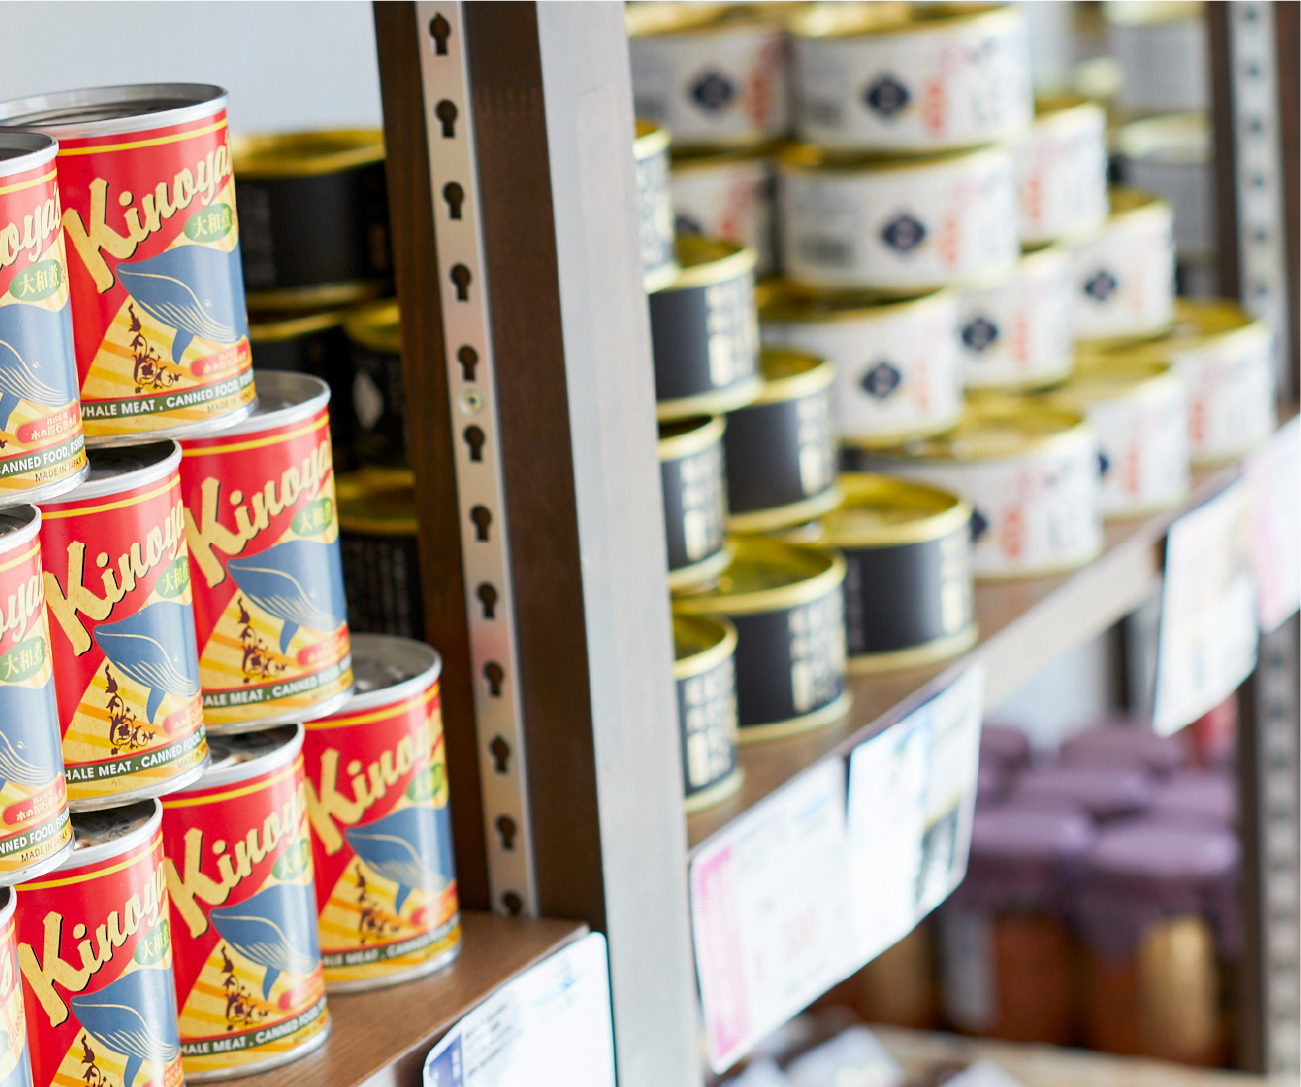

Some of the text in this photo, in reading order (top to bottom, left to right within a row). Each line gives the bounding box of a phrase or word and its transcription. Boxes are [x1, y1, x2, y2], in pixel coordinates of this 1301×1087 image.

[166, 388, 214, 408] CANNED
[35, 467, 58, 482] MADE
[64, 764, 94, 781] HALE
[98, 760, 132, 777] MEAT
[141, 746, 182, 768] CANNED
[21, 847, 44, 863] MADE
[181, 1040, 209, 1056] HALE
